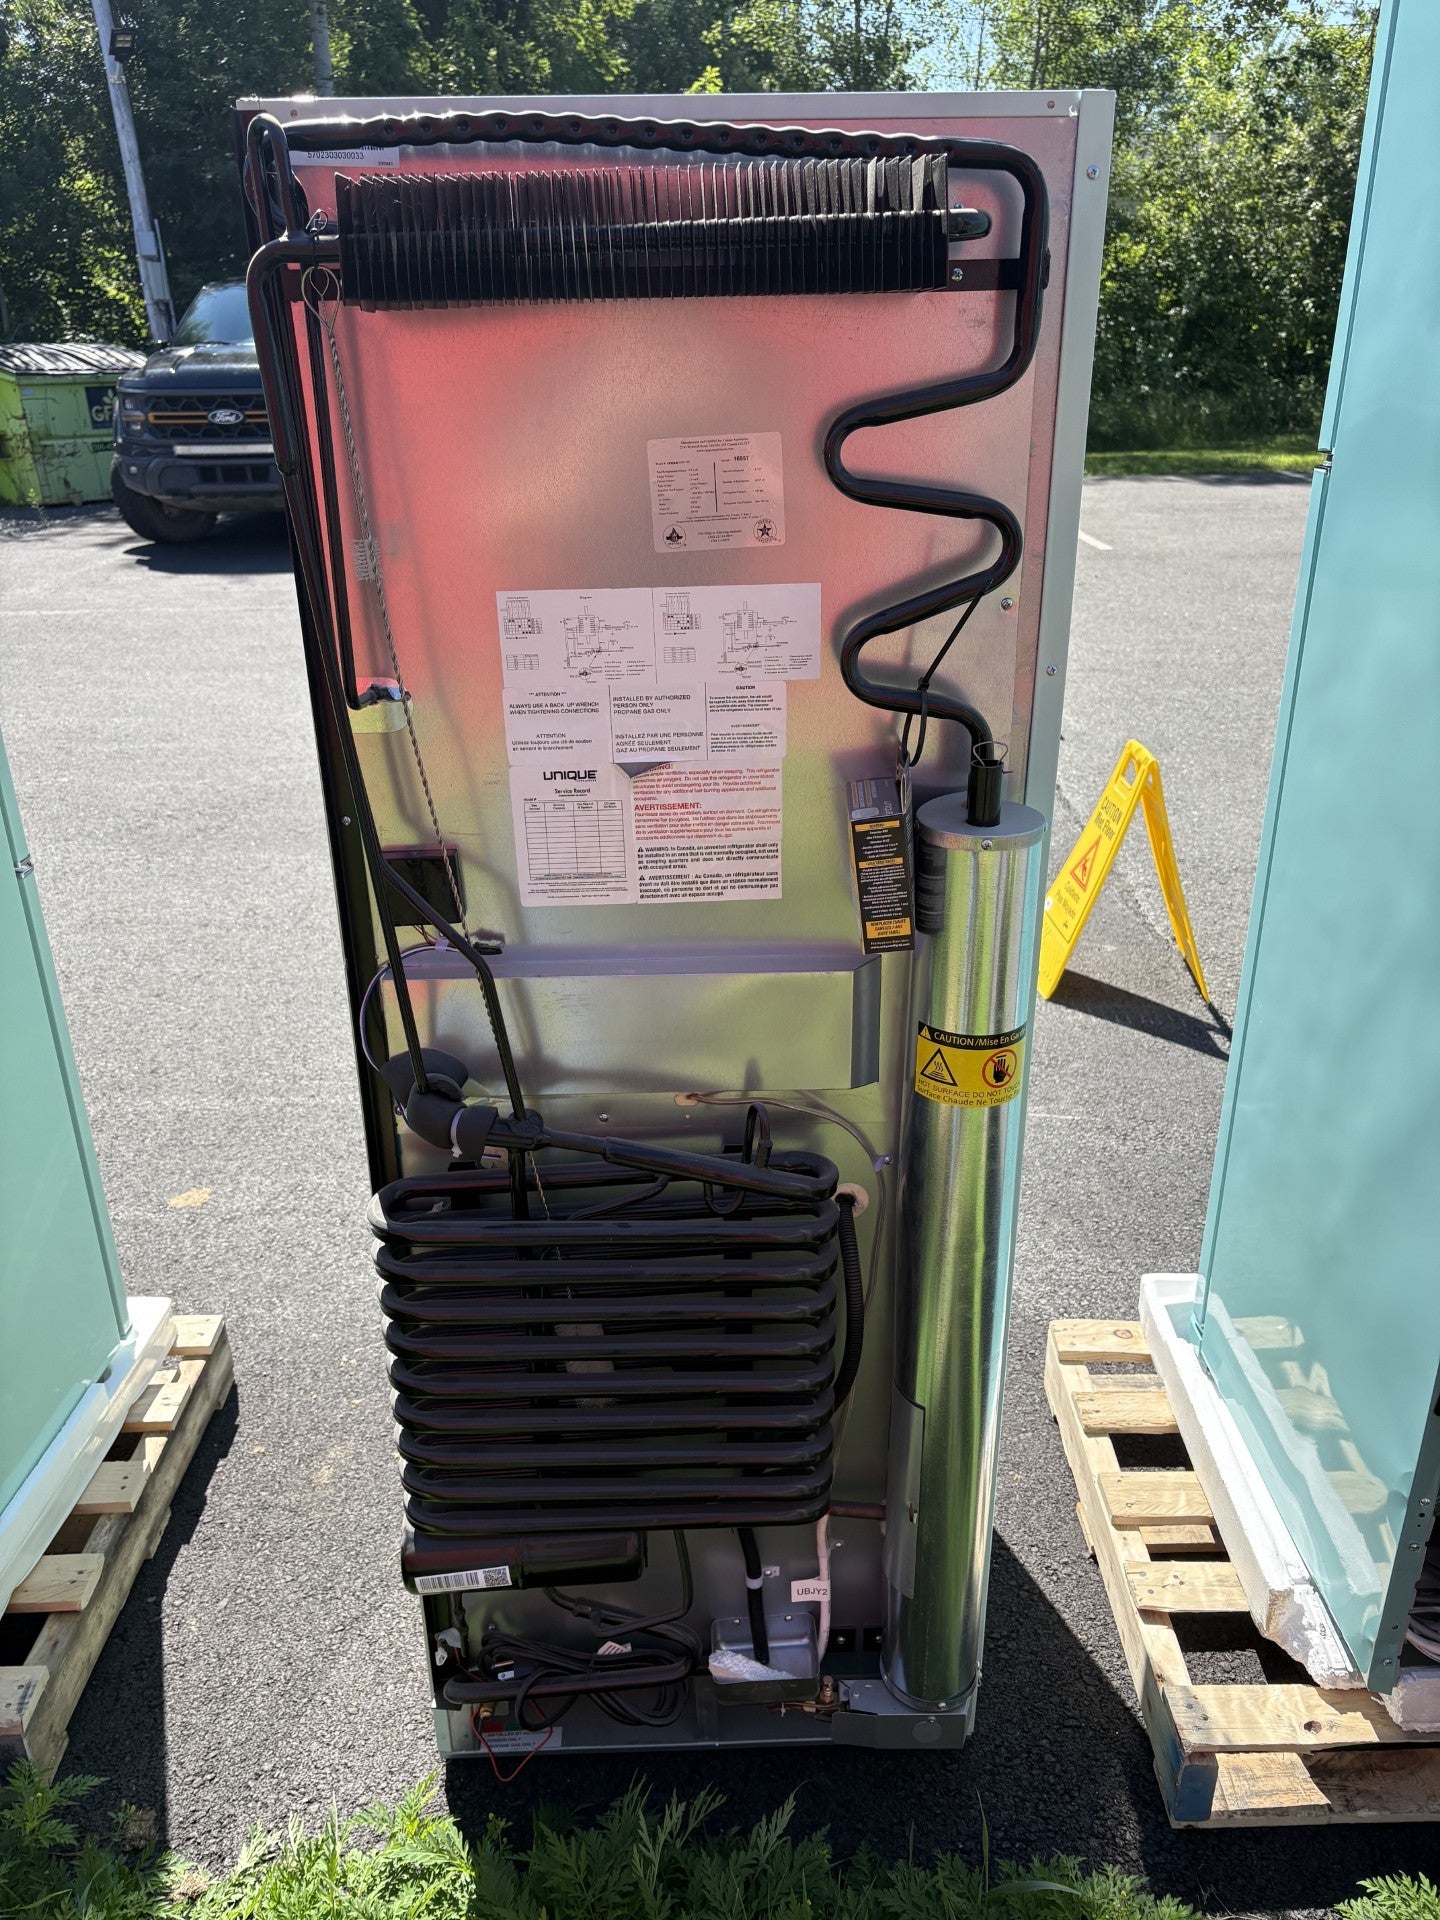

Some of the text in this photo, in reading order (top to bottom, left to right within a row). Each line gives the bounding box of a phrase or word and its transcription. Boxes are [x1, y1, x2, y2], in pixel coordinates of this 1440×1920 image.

[214, 412, 236, 422] Ford
[543, 770, 598, 781] UNIQUE
[635, 803, 702, 811] AVERTISSEMENT:
[1101, 796, 1122, 826] CAUTION
[1094, 811, 1115, 841] Wet Floor
[918, 1079, 930, 1088] HOT
[933, 1084, 970, 1098] SURFACE
[943, 1095, 974, 1106] Chaude
